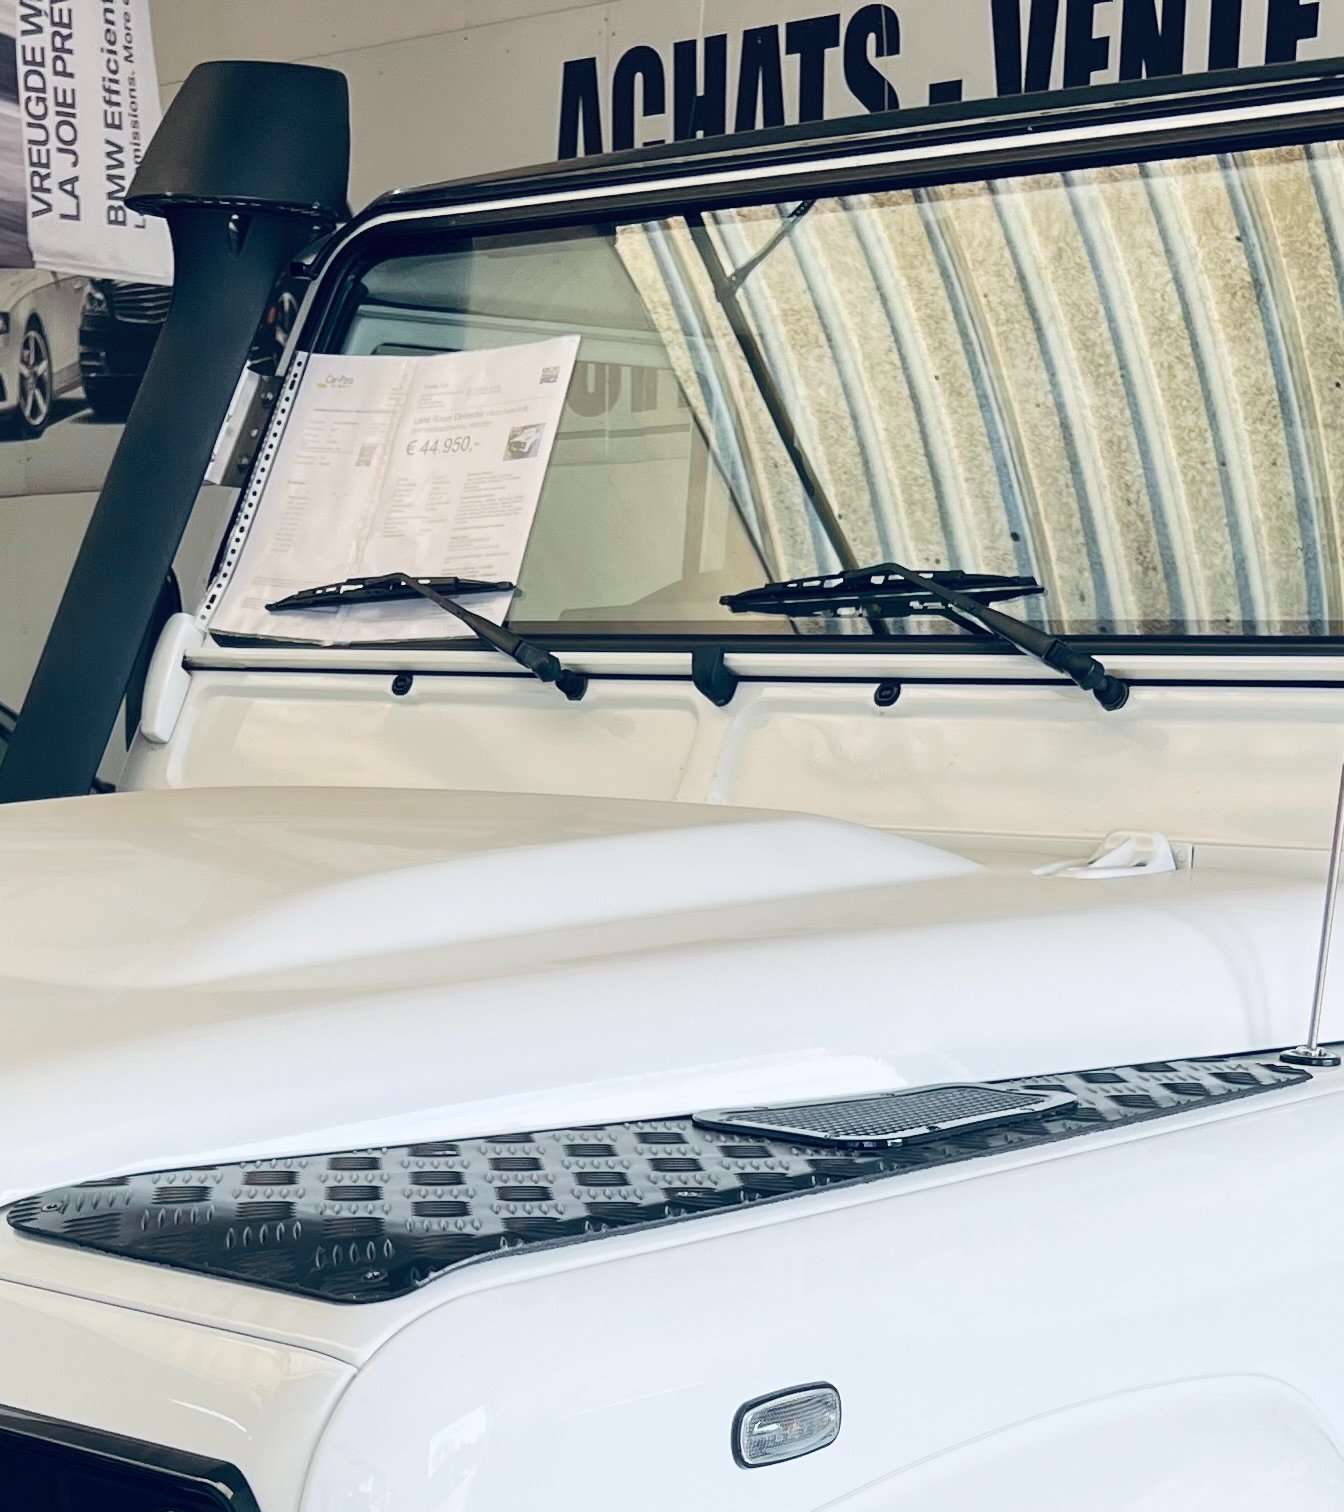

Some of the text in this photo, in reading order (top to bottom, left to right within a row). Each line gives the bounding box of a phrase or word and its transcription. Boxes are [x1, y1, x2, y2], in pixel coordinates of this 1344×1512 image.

[21, 45, 54, 218] VREUGDE
[45, 0, 81, 222] LA JOIE PRÉ
[100, 0, 128, 227] BMW Efficien
[558, 3, 901, 161] ACHATS
[405, 440, 416, 456] €
